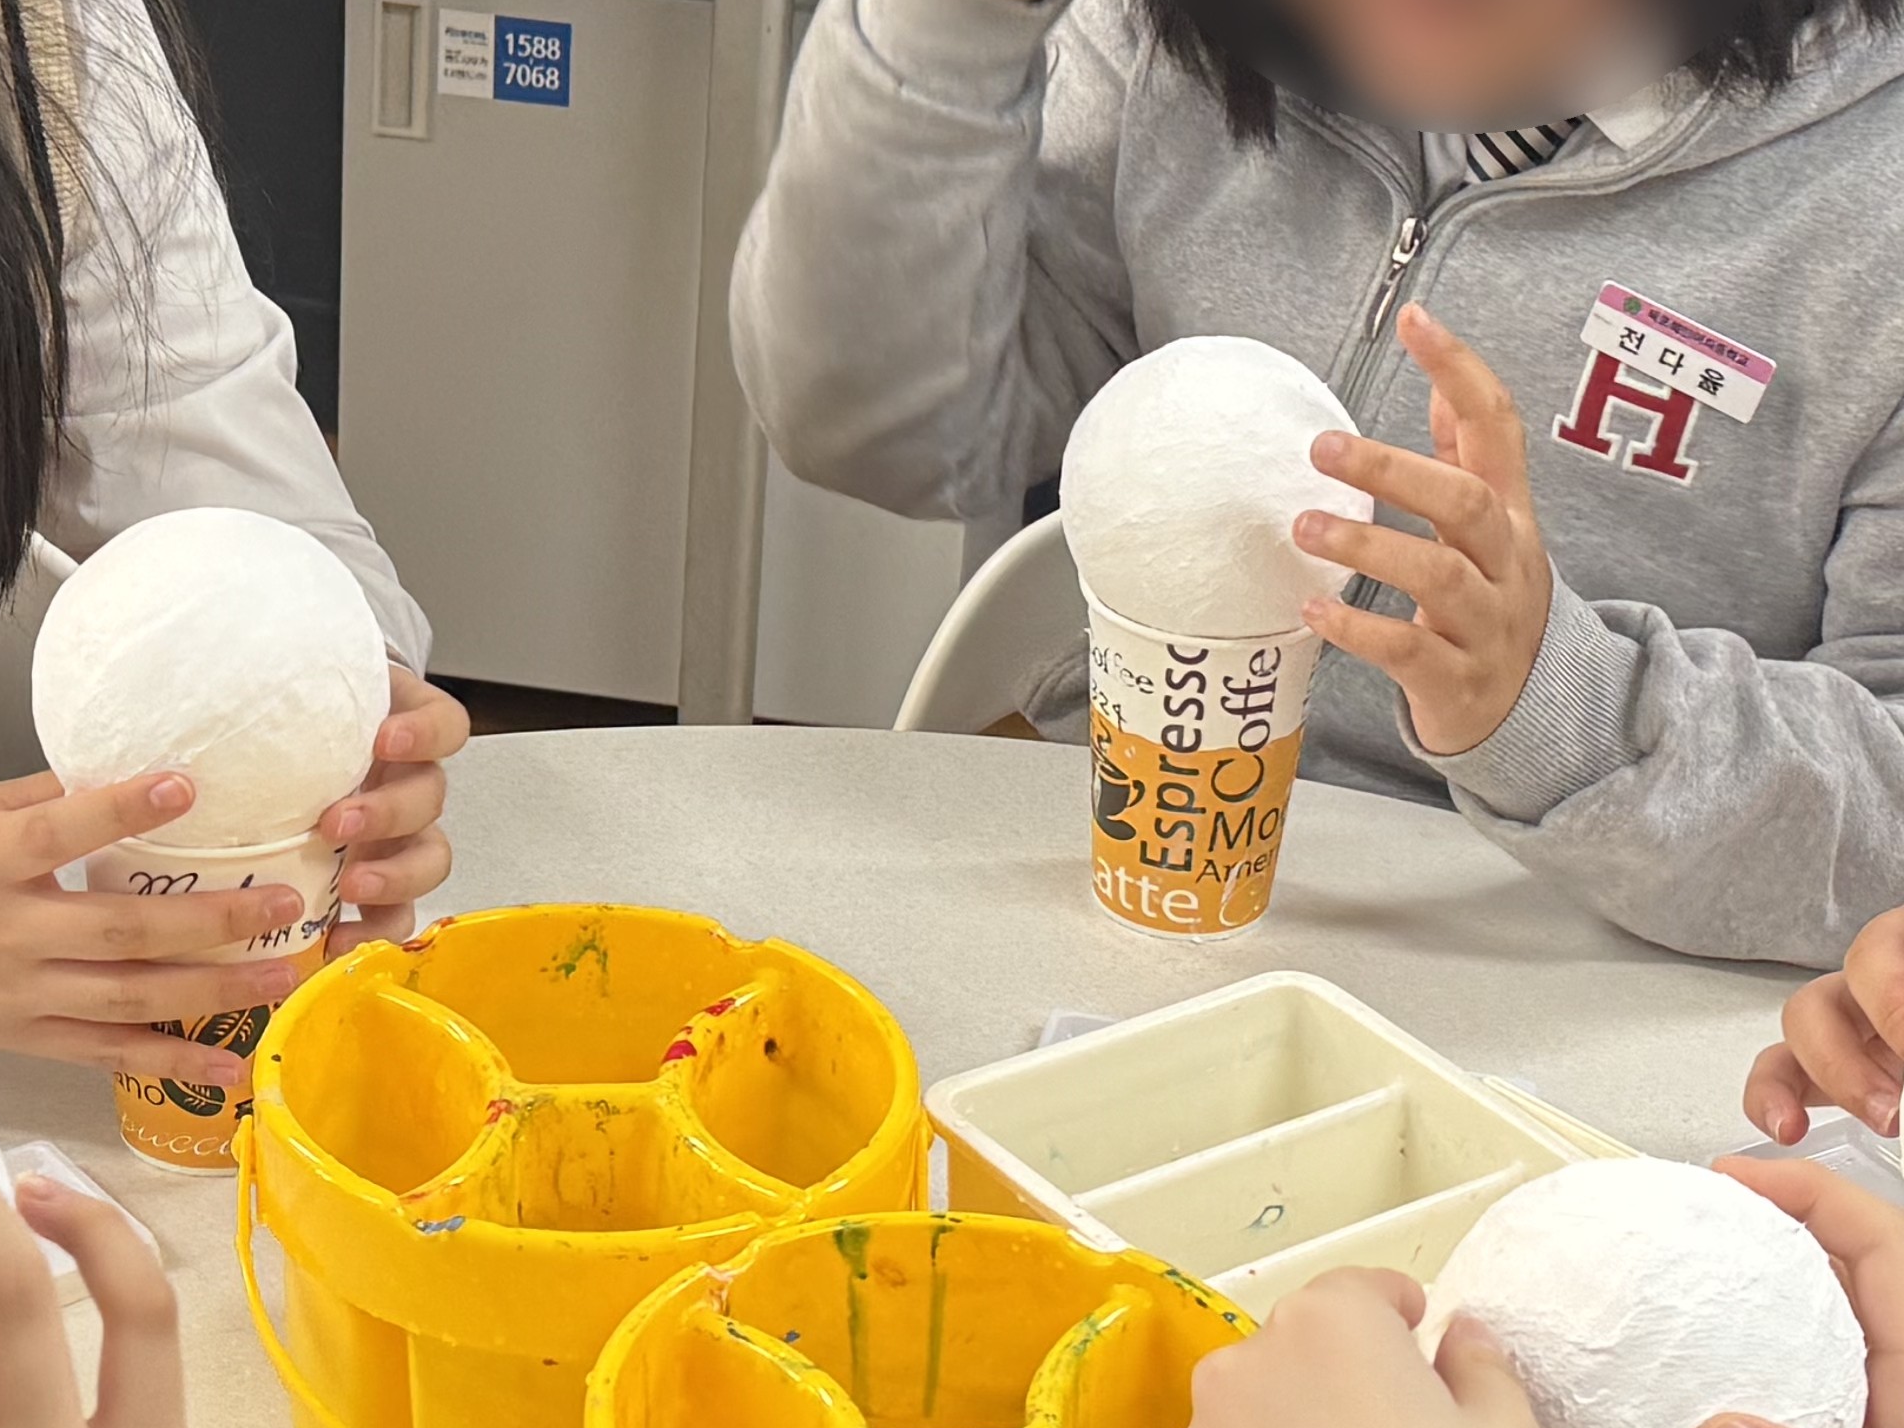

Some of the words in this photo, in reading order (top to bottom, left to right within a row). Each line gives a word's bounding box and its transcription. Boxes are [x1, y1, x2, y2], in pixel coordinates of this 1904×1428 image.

[505, 32, 561, 60] 1588
[503, 62, 560, 90] 7068
[1551, 348, 1699, 488] H
[1093, 855, 1201, 925] atte
